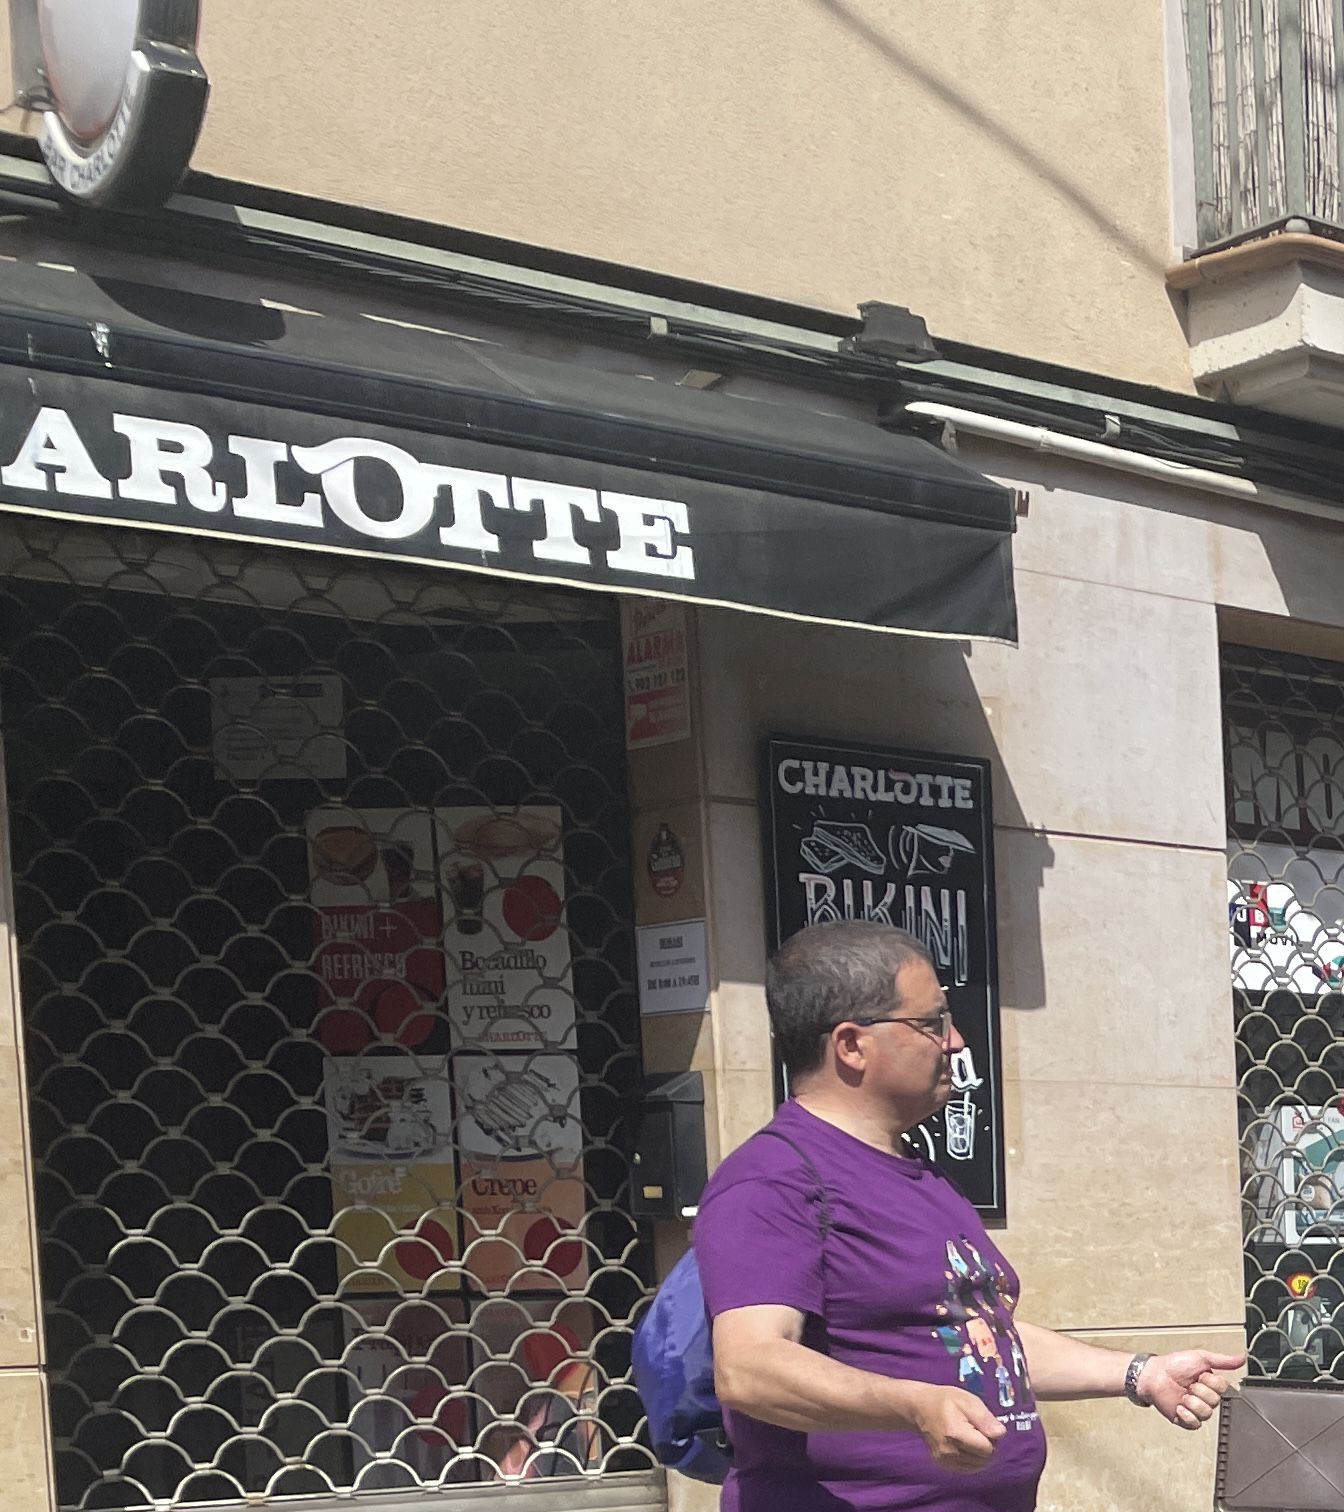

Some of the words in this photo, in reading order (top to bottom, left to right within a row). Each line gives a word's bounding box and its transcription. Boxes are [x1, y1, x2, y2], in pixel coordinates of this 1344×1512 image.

[1, 406, 694, 581] ARLOTTE
[777, 759, 974, 809] CHARLOTTE
[321, 913, 375, 941] BIKINI
[798, 872, 969, 988] BIKINI
[321, 953, 408, 981] REFRESCO
[459, 949, 548, 971] Bocadillo
[477, 1003, 552, 1020] resco
